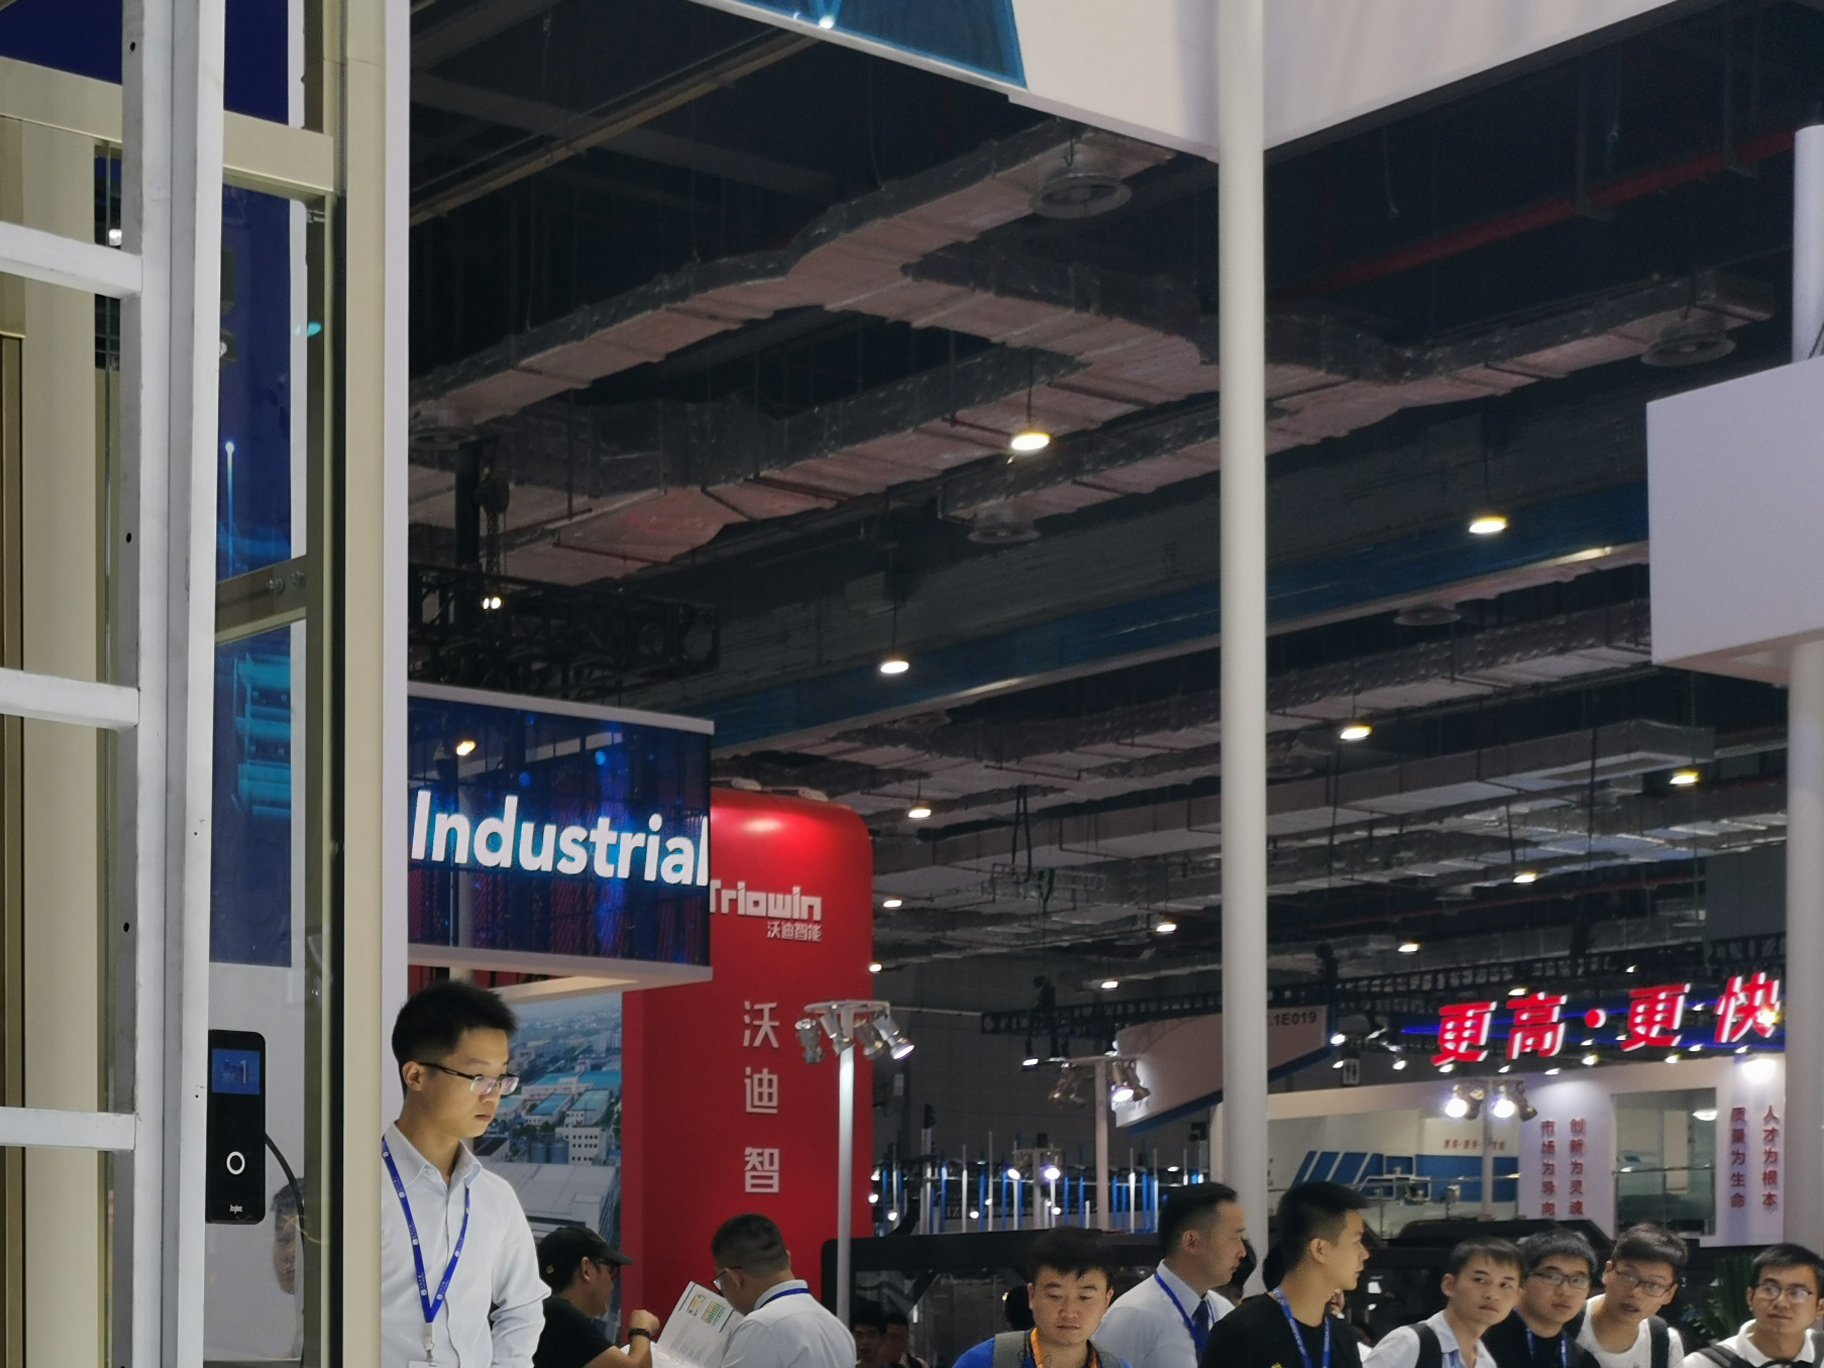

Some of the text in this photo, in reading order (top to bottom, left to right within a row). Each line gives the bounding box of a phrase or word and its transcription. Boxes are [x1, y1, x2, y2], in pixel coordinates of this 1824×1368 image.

[411, 790, 709, 887] Industrial
[767, 921, 822, 942] 沃迪智能
[743, 1000, 780, 1193] 沃迪智
[1541, 1120, 1555, 1216] 市场为导向
[1731, 1107, 1745, 1208] 质量为生命
[1762, 1105, 1779, 1206] 人才为根本
